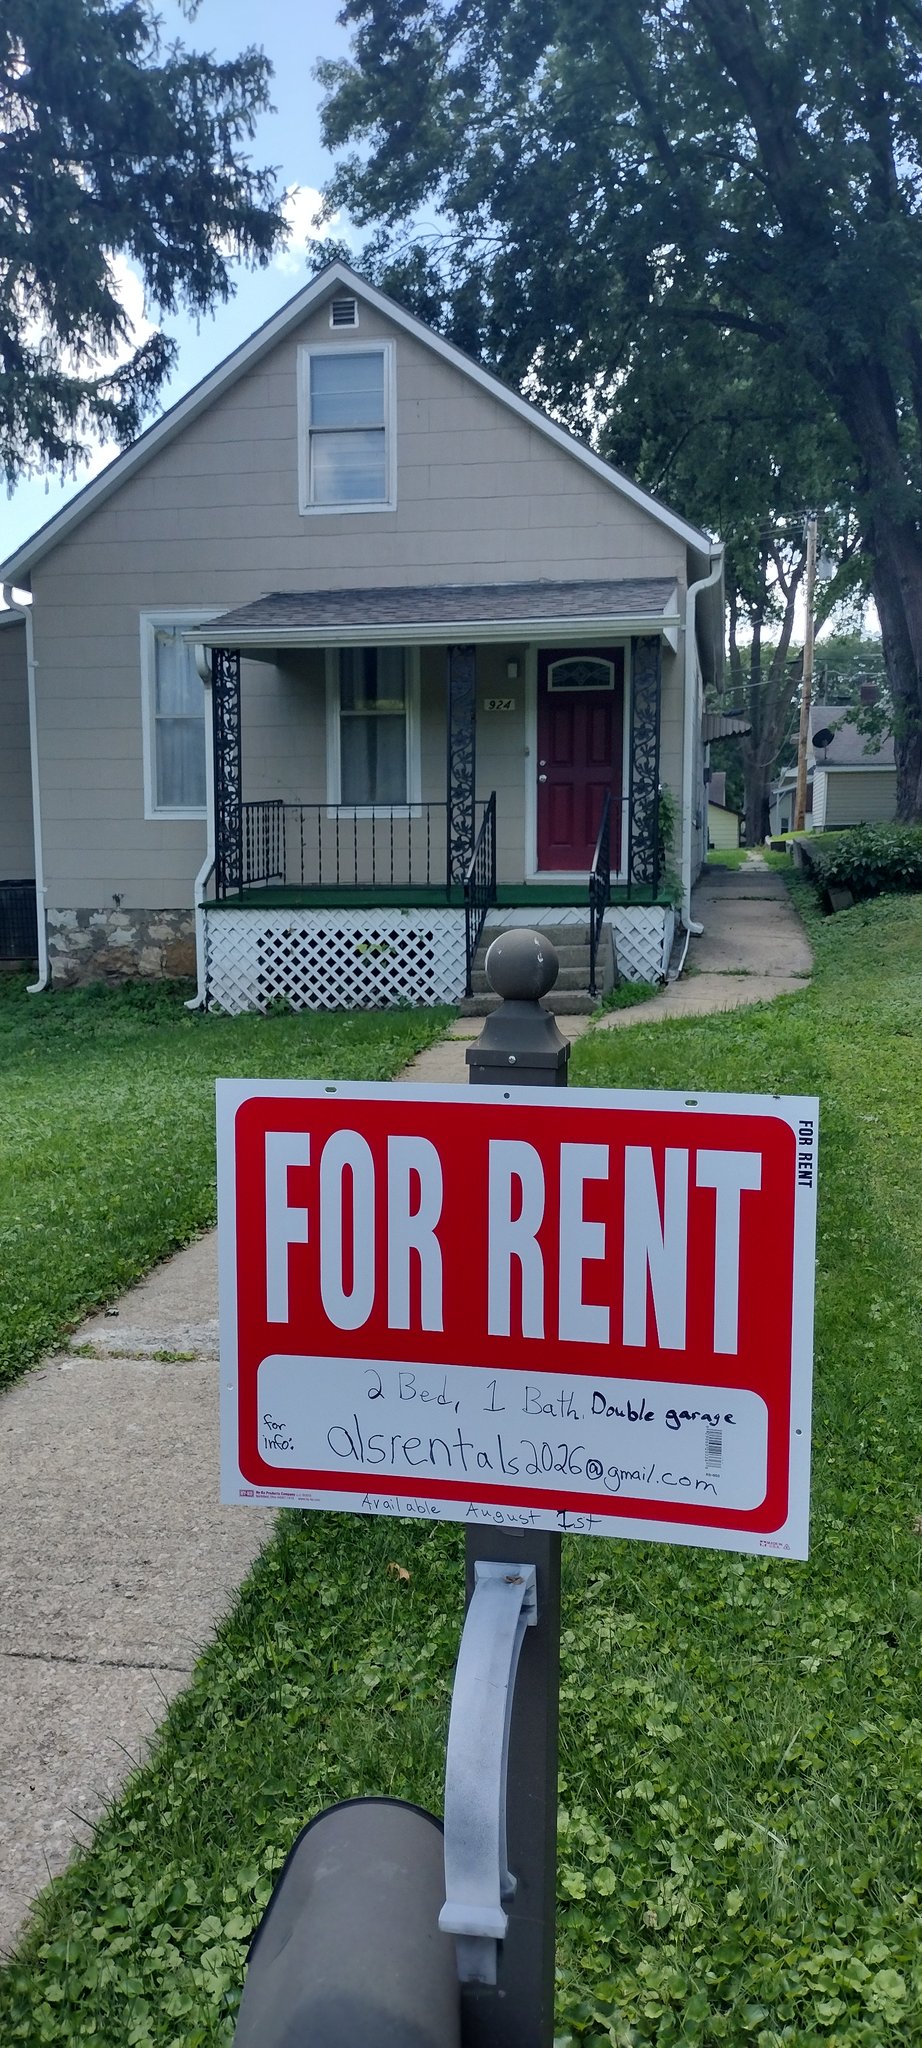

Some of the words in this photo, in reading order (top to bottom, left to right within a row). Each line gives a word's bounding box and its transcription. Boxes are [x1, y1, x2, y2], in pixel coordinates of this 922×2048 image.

[488, 699, 512, 710] 924
[798, 1120, 814, 1146] FOR
[797, 1152, 813, 1189] RENT
[265, 1129, 444, 1332] FOR
[487, 1139, 762, 1355] RENT
[364, 1368, 385, 1400] 2
[398, 1372, 461, 1414] Bed,
[483, 1379, 506, 1413] 1
[591, 1391, 655, 1423] Double
[665, 1408, 737, 1431] garage
[262, 1413, 287, 1432] for
[262, 1433, 295, 1452] info:
[327, 1413, 717, 1496] alsrentals2026@gmail.com
[360, 1492, 441, 1516] Available
[465, 1501, 542, 1525] August
